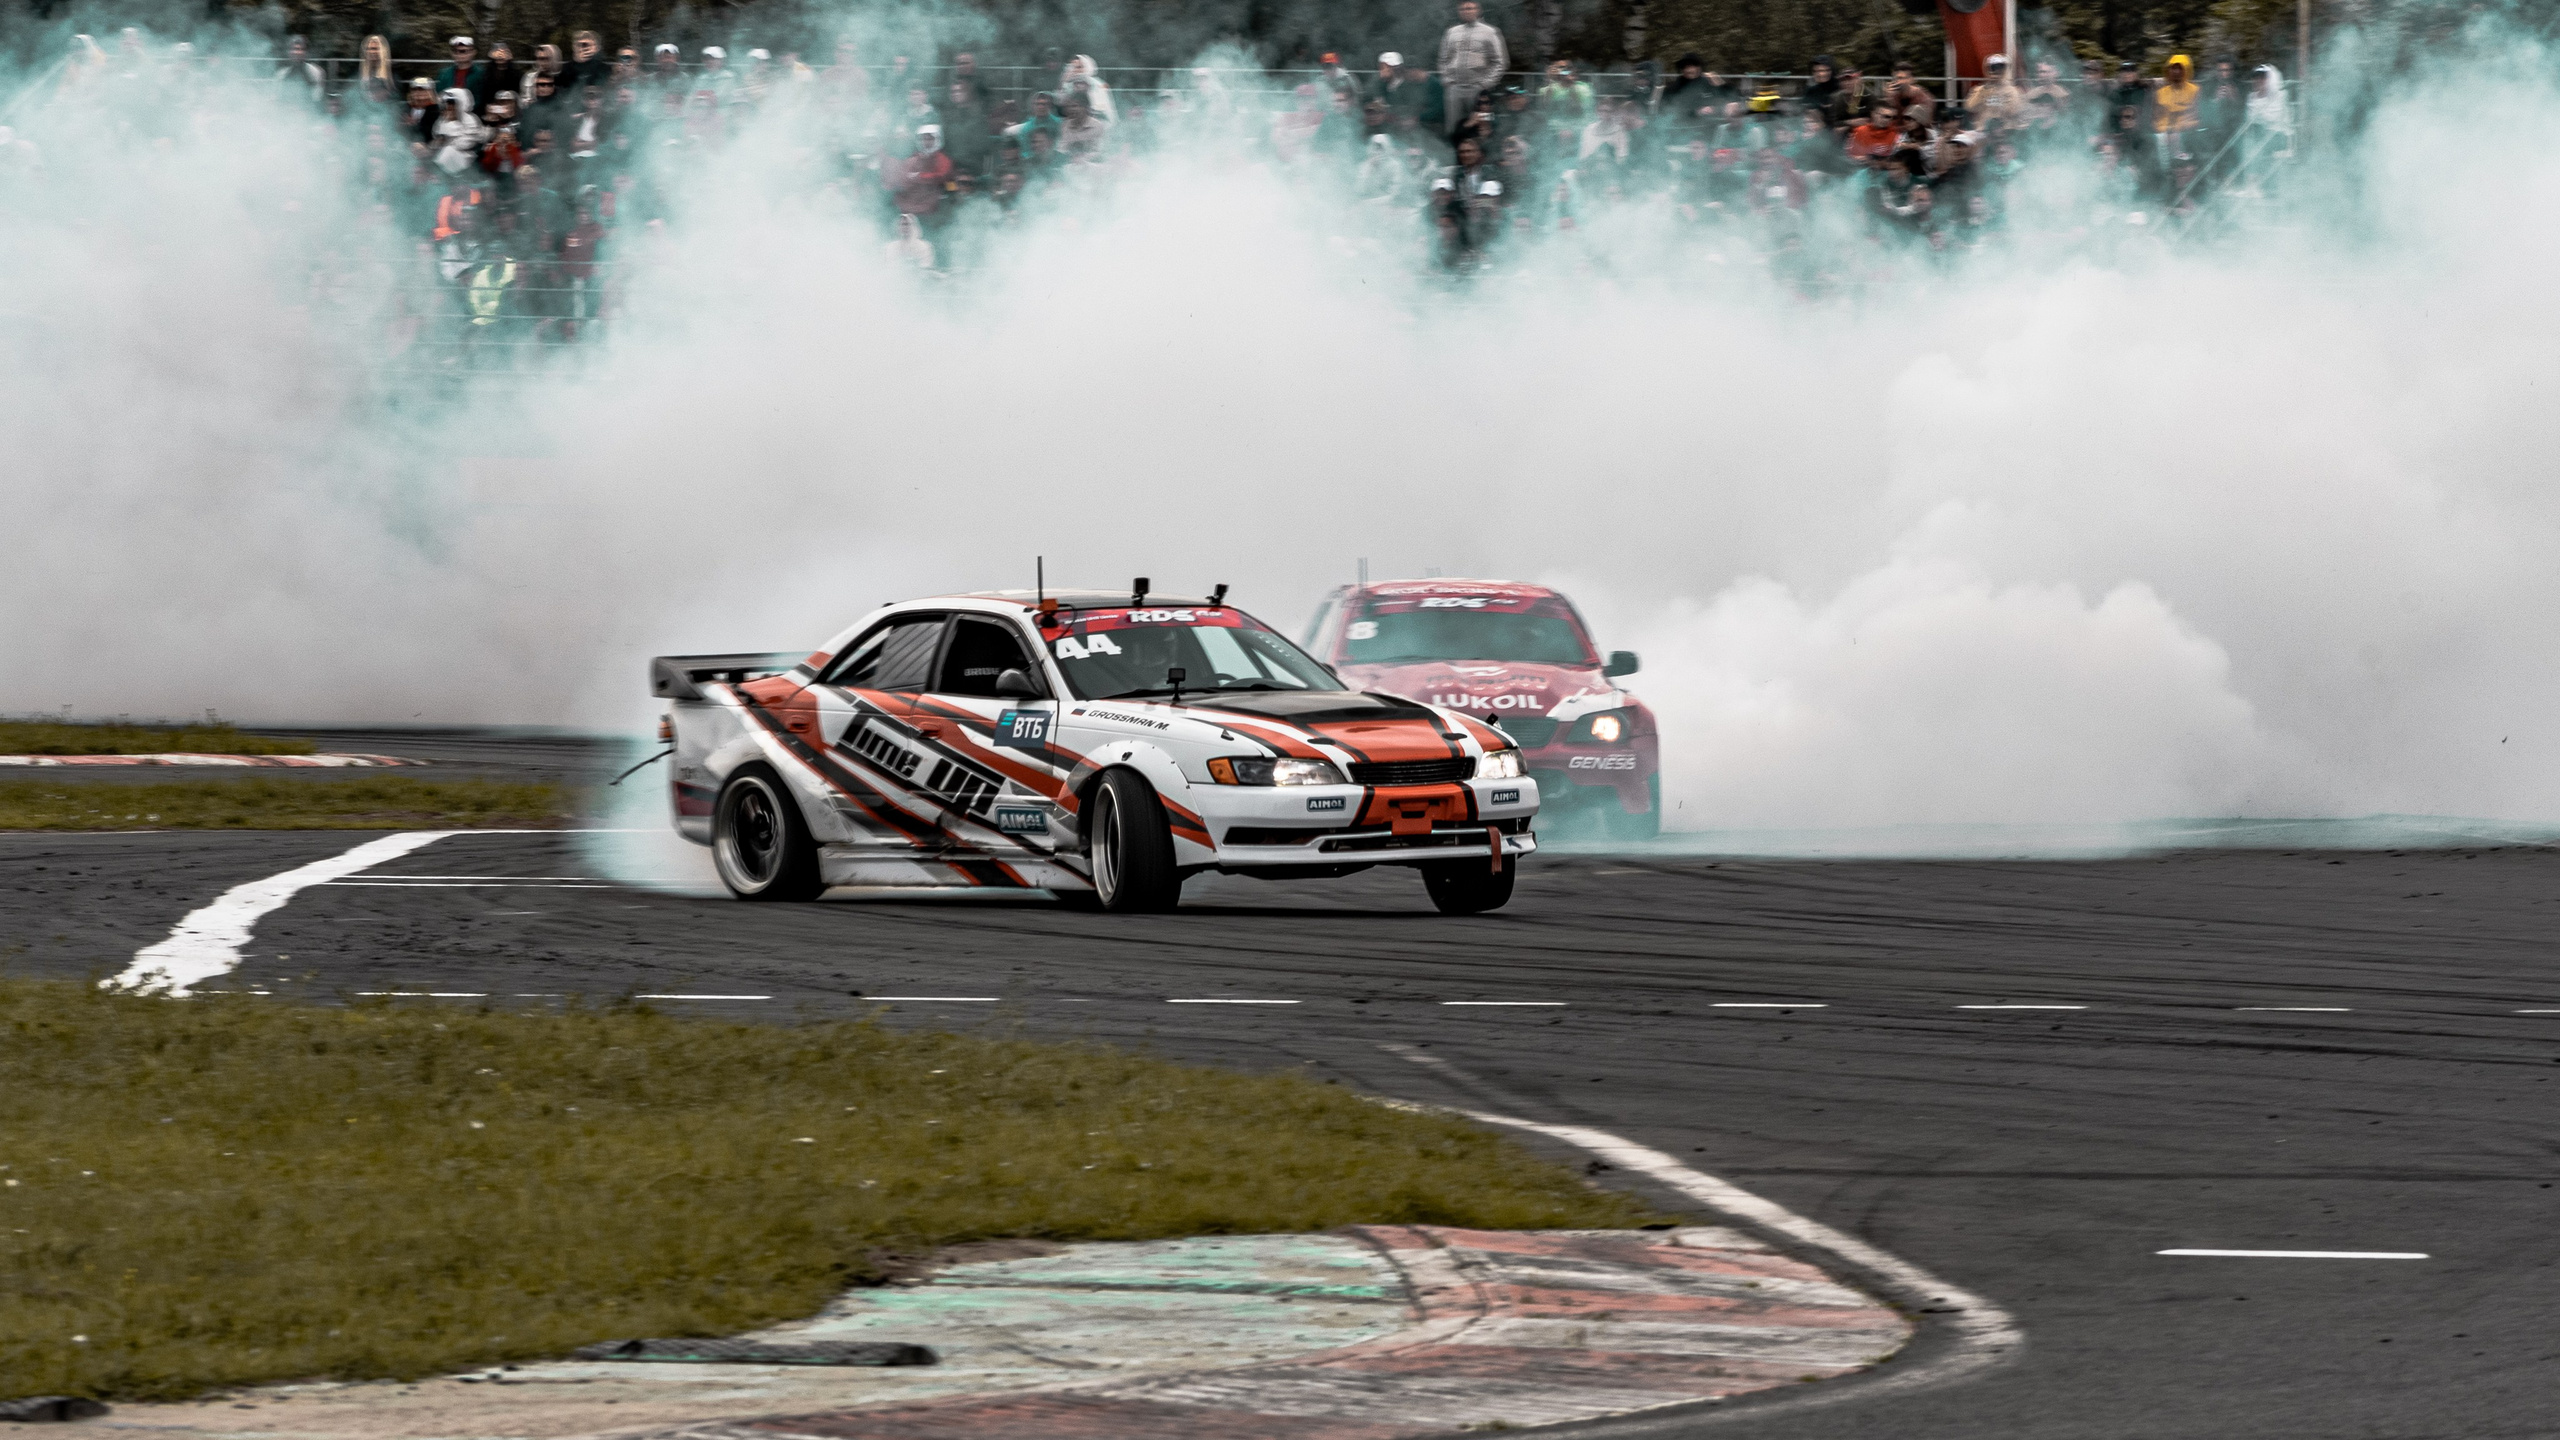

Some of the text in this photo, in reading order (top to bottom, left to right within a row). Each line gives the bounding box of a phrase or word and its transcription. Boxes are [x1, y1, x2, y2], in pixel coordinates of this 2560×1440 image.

[1127, 610, 1196, 623] RDS
[1345, 620, 1379, 640] 8
[1056, 634, 1122, 660] 44
[1432, 693, 1544, 710] LUKOIL
[1012, 716, 1045, 739] ВТБ
[1088, 709, 1156, 728] GROSSMAN
[1309, 799, 1344, 809] AIMOL
[1493, 791, 1519, 802] AIMOL
[1000, 811, 1044, 829] AIMOL
